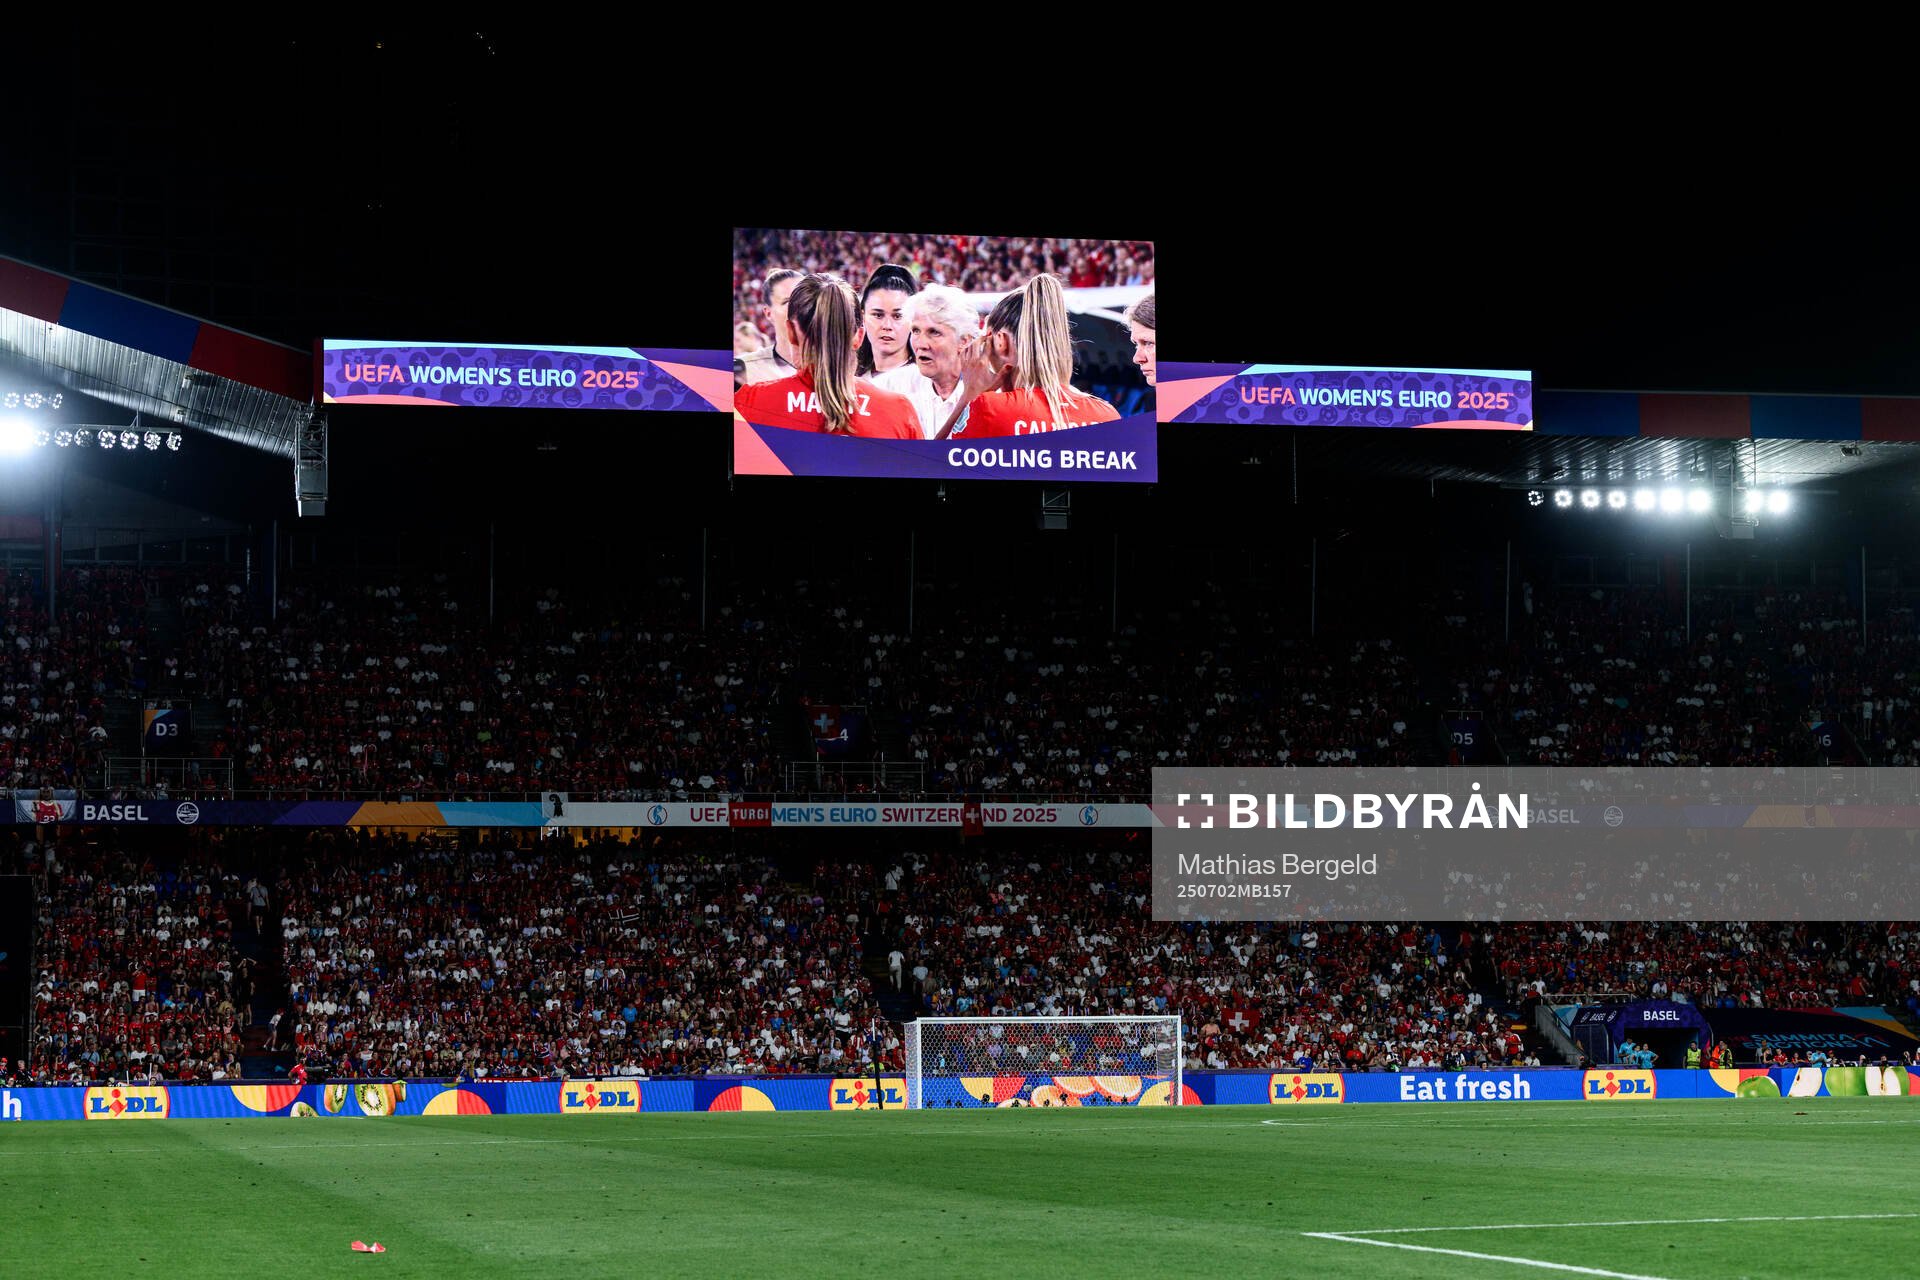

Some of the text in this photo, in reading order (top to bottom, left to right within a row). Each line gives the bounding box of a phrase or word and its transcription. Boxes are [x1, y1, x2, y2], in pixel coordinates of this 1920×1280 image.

[345, 364, 639, 388] UEFA WOMEN'S EURO 2025
[1242, 387, 1508, 409] UEFA WOMEN'S EURO 2025
[949, 448, 1137, 470] COOLING BREAK
[84, 805, 149, 820] BASEL
[691, 808, 728, 822] UEF
[830, 808, 876, 822] EURO
[882, 808, 1007, 822] SWITZERND
[1013, 808, 1057, 822] 2025
[733, 809, 769, 820] TURGI
[1643, 1010, 1680, 1021] BASEL
[1401, 1074, 1530, 1100] Eat fresh
